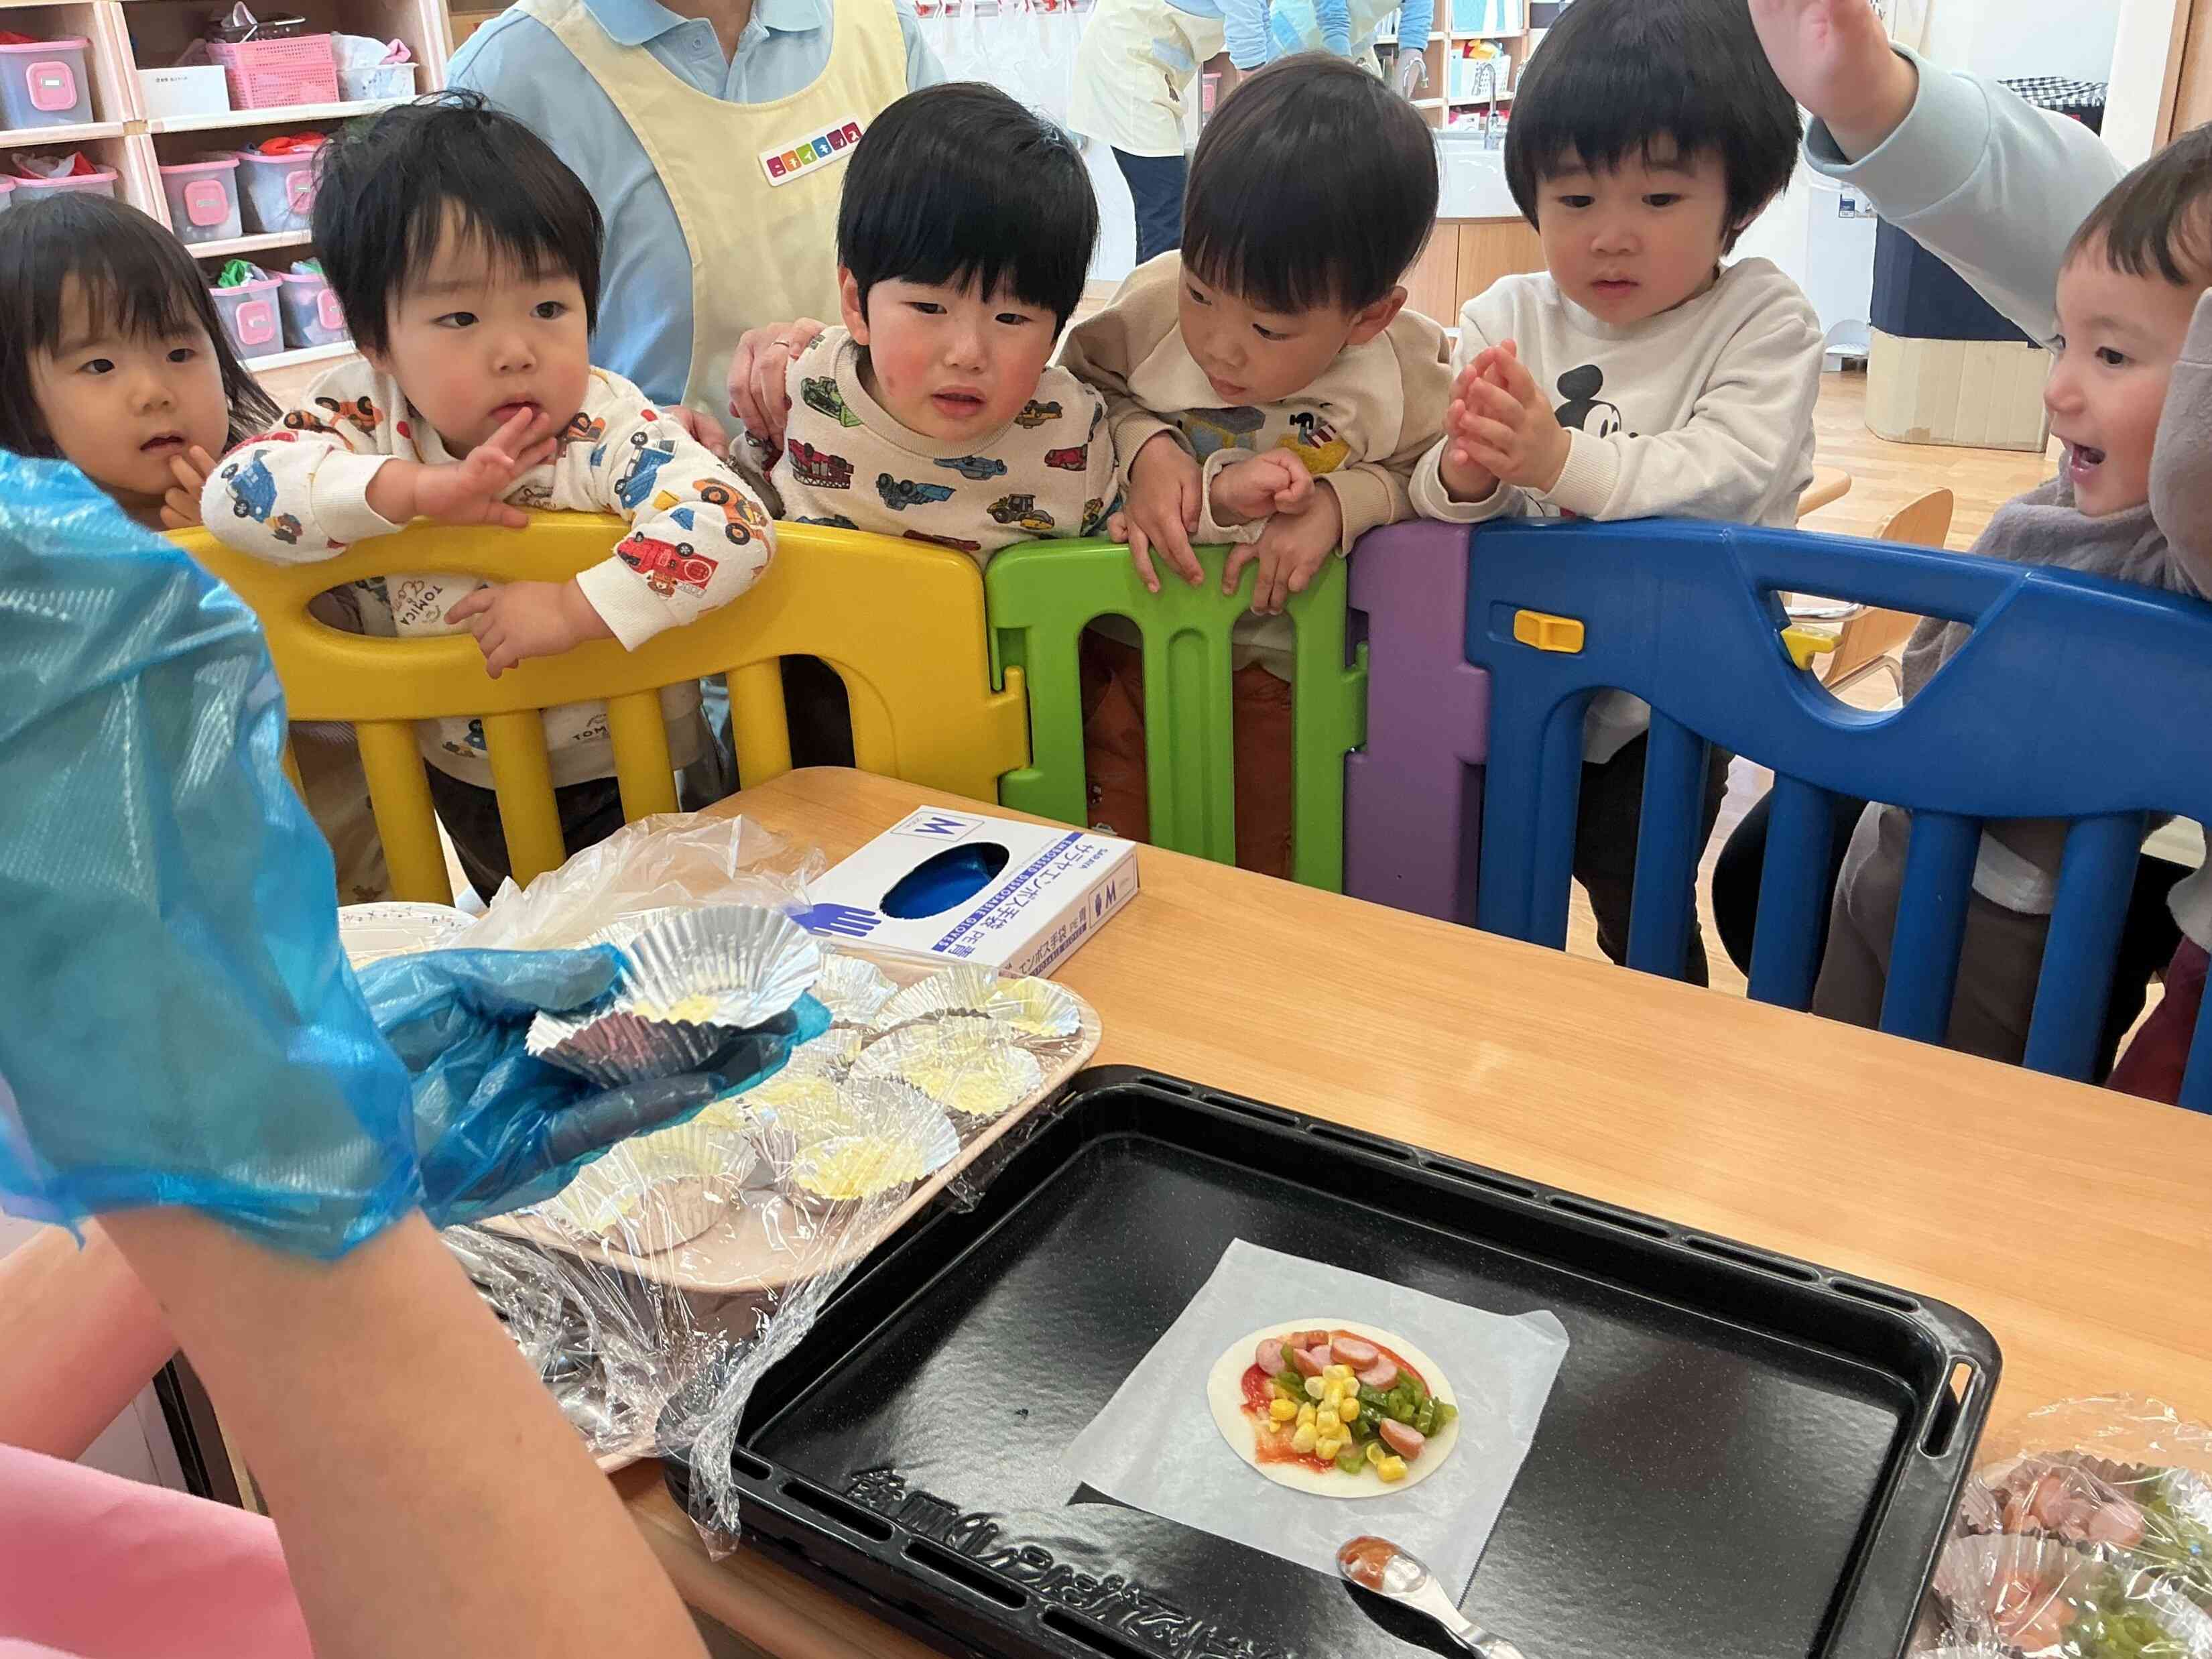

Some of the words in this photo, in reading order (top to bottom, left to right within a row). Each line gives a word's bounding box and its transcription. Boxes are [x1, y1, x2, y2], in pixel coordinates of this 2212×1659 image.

[400, 585, 443, 625] TOMICA
[914, 817, 967, 835] M
[1028, 840, 1072, 873] EMBOSSED
[1080, 848, 1108, 869] SARAYA
[978, 873, 1030, 916] DISPOSABLE
[980, 844, 1094, 929] サラヤエンボス手袋
[1106, 879, 1115, 909] M
[938, 917, 977, 947] GLOVES
